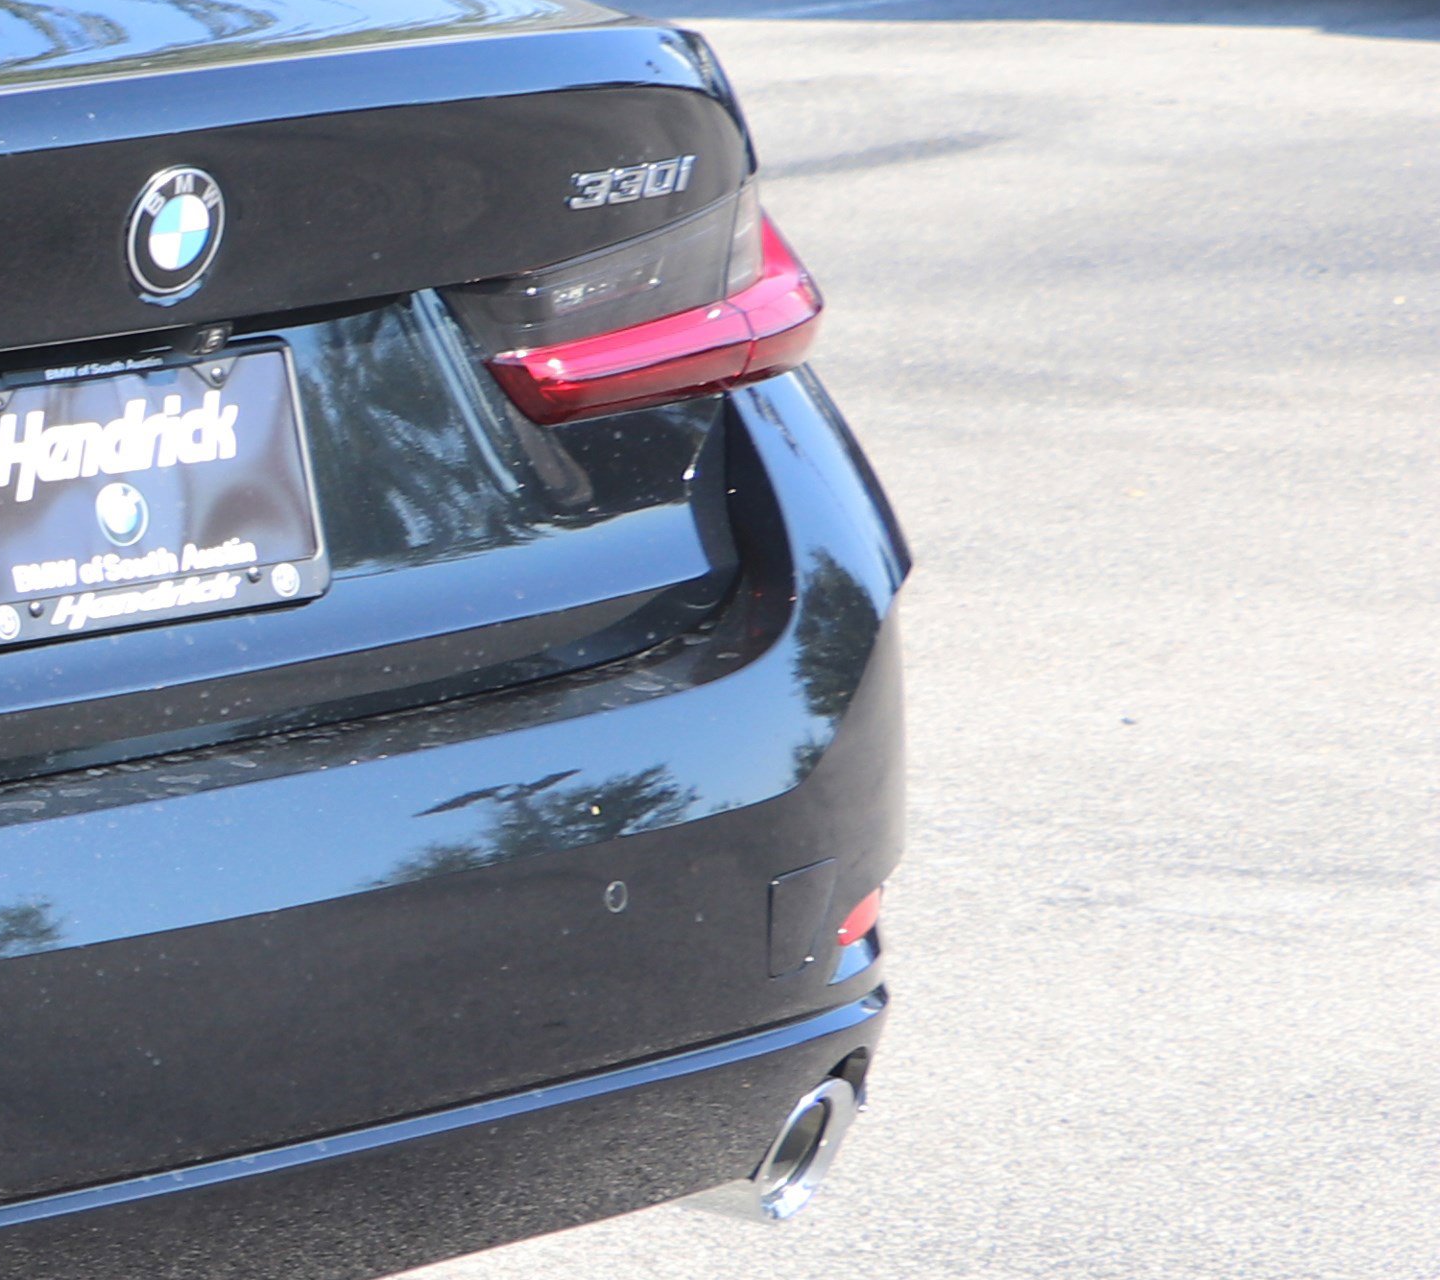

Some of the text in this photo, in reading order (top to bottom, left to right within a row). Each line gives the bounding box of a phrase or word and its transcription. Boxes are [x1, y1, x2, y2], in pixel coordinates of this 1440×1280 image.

[145, 171, 222, 219] BMW
[564, 154, 698, 210] 330i
[44, 367, 76, 381] BMW
[91, 361, 126, 376] South
[125, 356, 164, 373] Austin
[11, 536, 257, 594] BMW of South Austin
[49, 572, 242, 630] Hendrick
